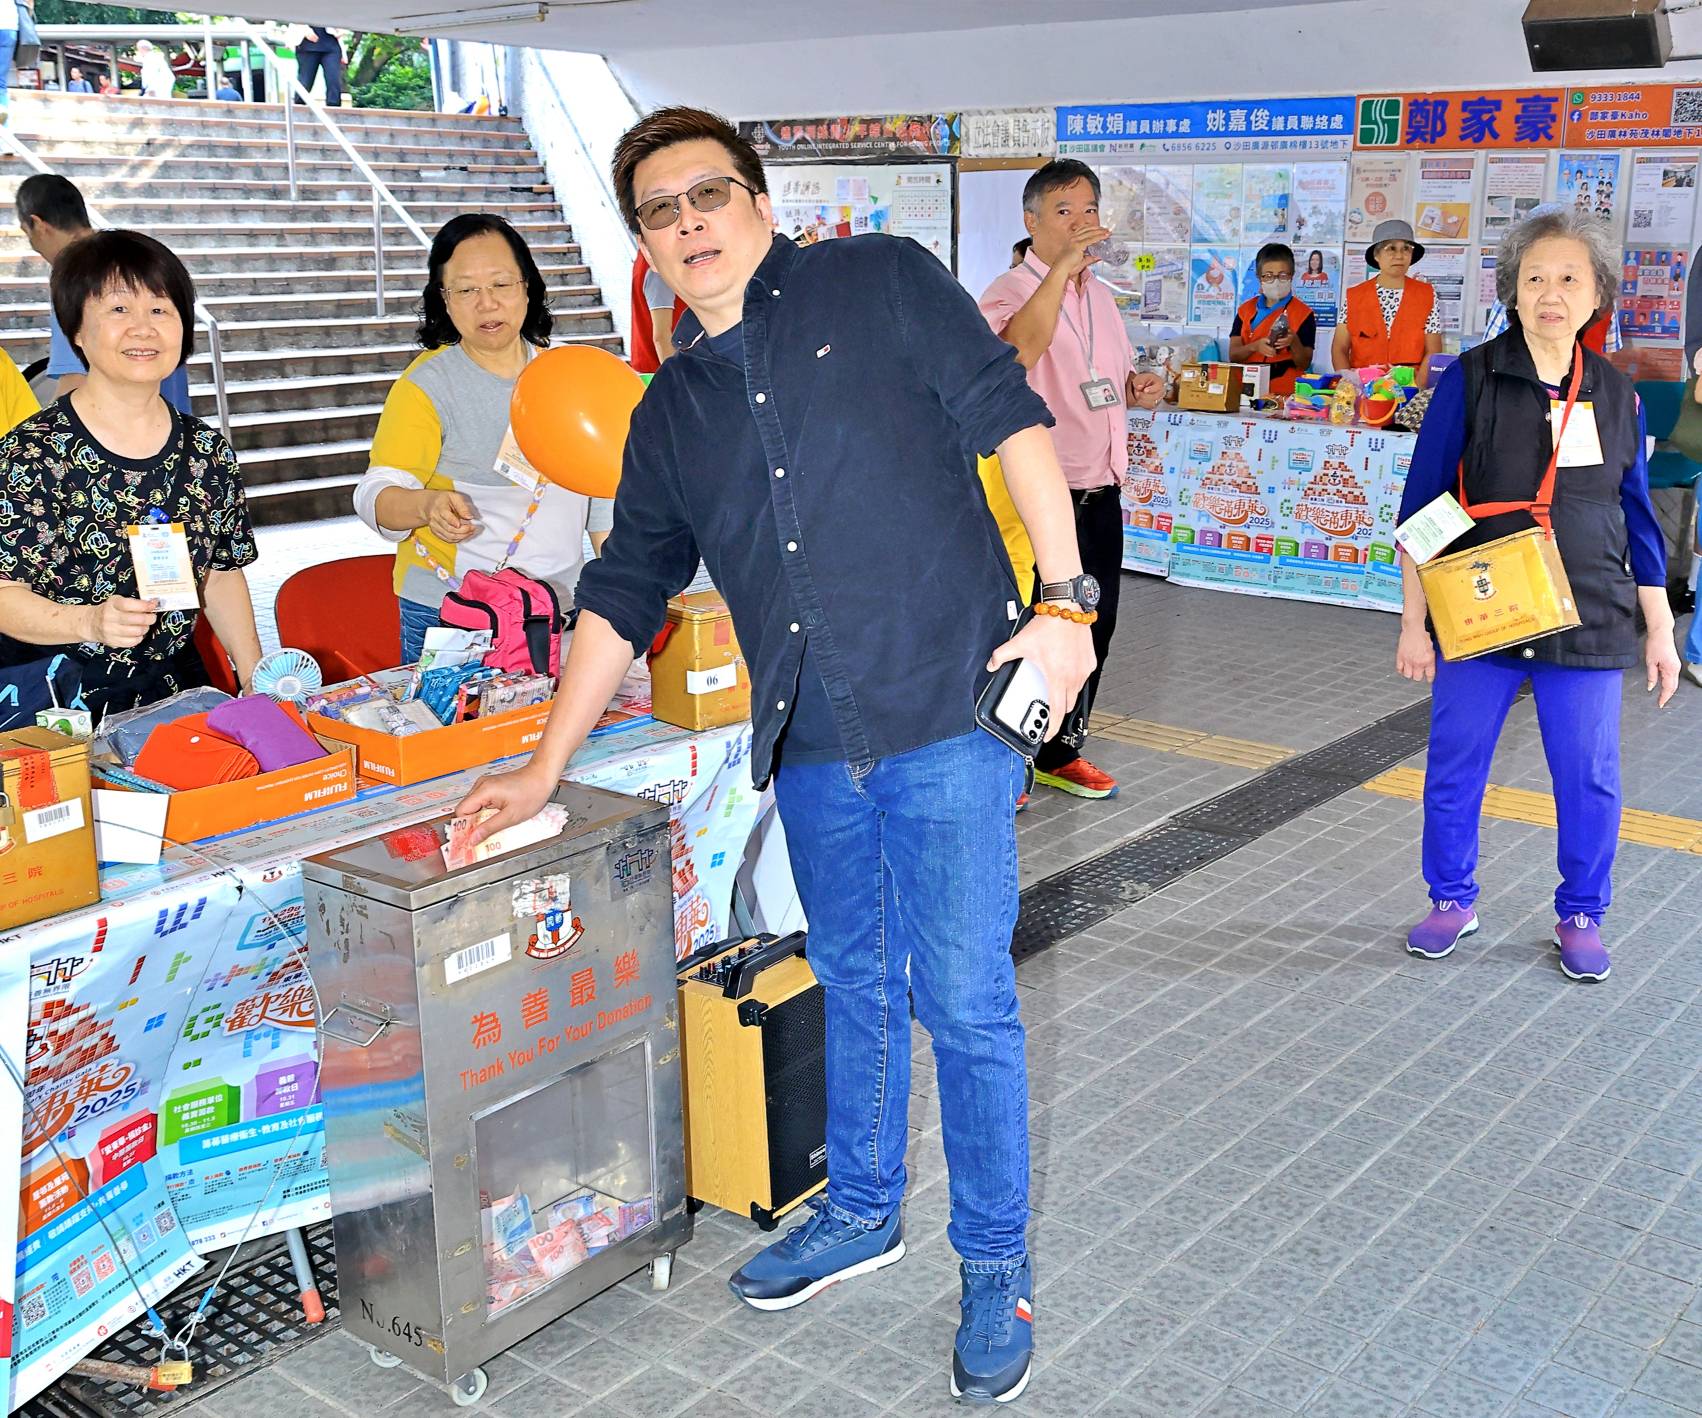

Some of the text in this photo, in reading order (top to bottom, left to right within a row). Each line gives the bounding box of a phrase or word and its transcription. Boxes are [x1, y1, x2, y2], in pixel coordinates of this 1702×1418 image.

[1590, 92, 1640, 102] 9333 1844
[1067, 112, 1191, 136] 陳敏娟議員辦事處
[1405, 94, 1560, 144] 鄭家豪
[816, 142, 850, 150] INTEGRATED
[850, 141, 873, 149] SERVICE
[1152, 494, 1169, 506] 2025
[1249, 515, 1270, 527] 2025
[706, 674, 719, 686] 06
[322, 769, 347, 781] Choice
[363, 759, 395, 777] FUJIFILM
[303, 781, 348, 802] FUJIFILM
[453, 818, 467, 833] 100
[484, 841, 502, 853] 100
[8, 900, 17, 909] OF
[22, 888, 65, 905] HOSPITALS
[470, 948, 641, 1050] 為善最樂
[459, 993, 653, 1091] Thank You For Your Donation
[74, 1081, 138, 1123] 2025
[530, 1231, 554, 1248] 100
[549, 1245, 564, 1263] 100
[172, 1260, 196, 1281] HKT
